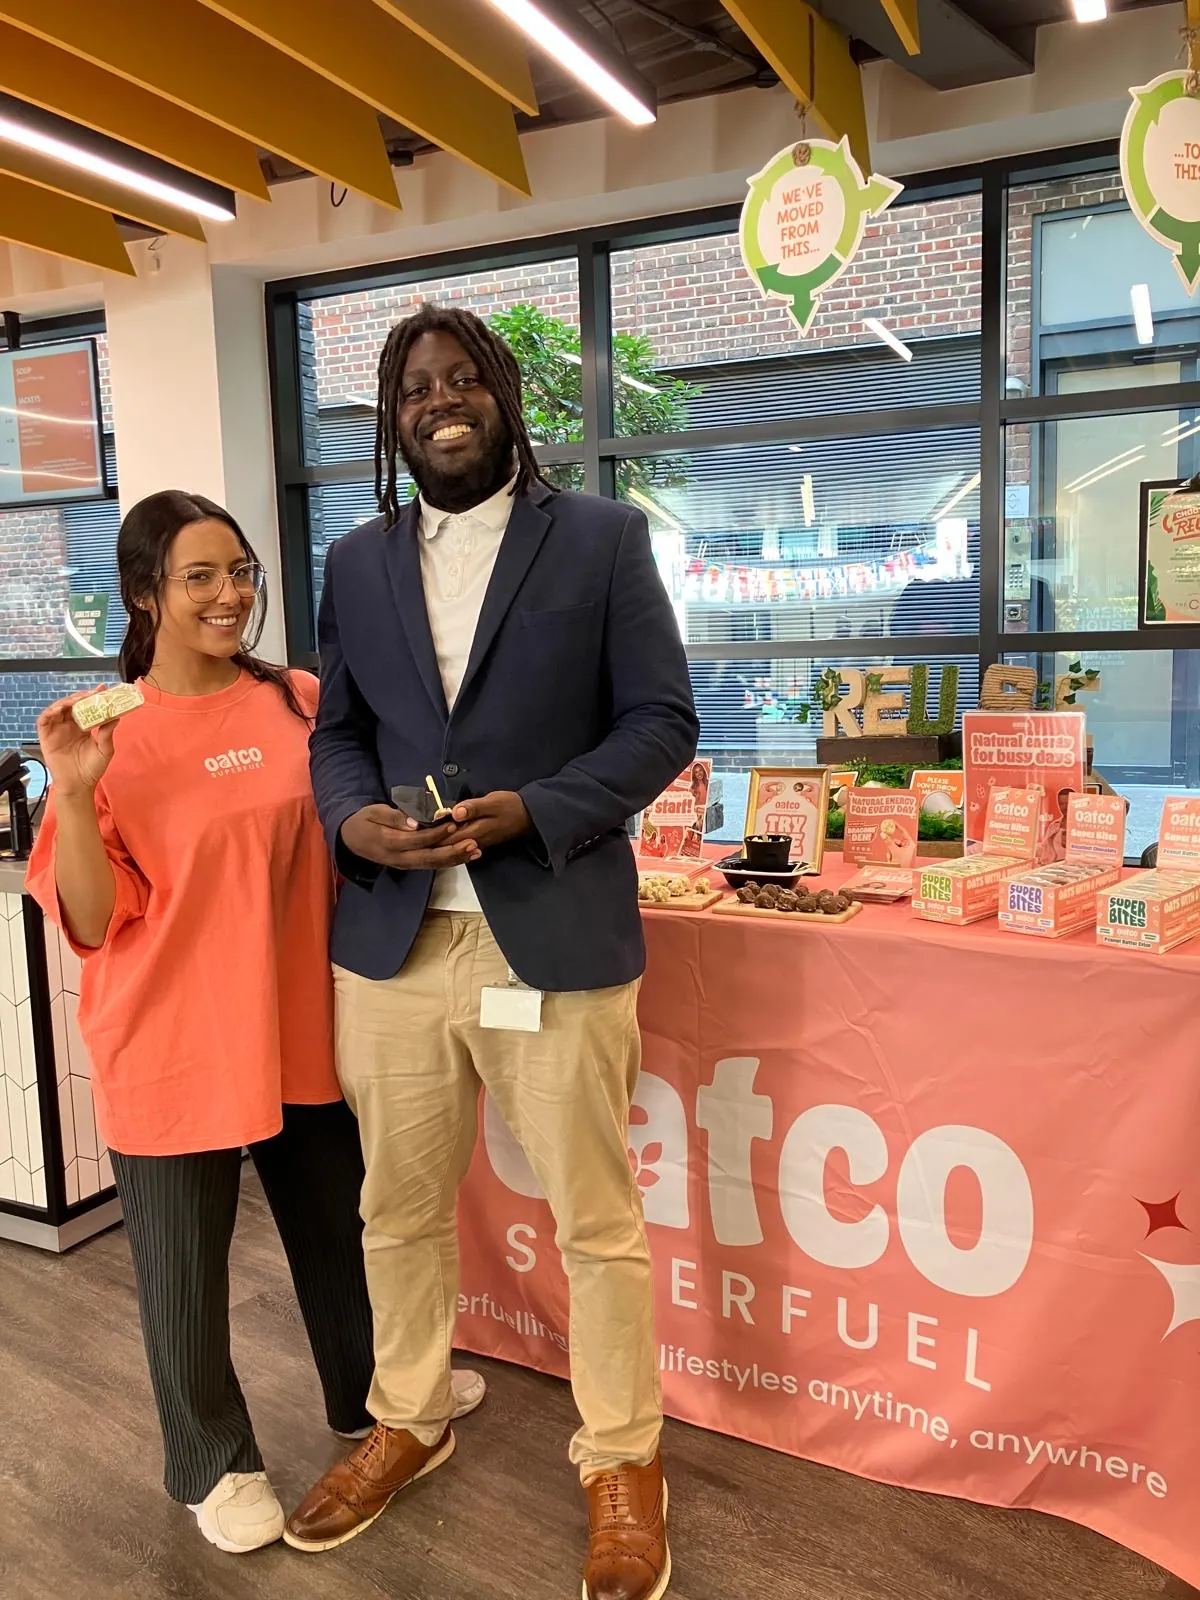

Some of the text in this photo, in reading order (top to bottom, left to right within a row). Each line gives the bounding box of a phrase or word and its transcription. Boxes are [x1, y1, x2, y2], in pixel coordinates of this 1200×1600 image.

[782, 182, 823, 205] WE'VE
[777, 201, 824, 225] MOVED
[781, 220, 819, 241] FROM
[781, 241, 820, 259] THIS...
[972, 734, 1023, 748] Natural
[204, 746, 263, 772] oatco
[972, 748, 1074, 766] for busy days
[655, 799, 693, 814] start!
[851, 805, 914, 814] FOR EVERY DAY
[852, 797, 915, 806] NATURAL ENERGY
[994, 802, 1029, 817] oatco
[766, 814, 807, 833] TRY
[1075, 810, 1115, 826] oatco
[921, 873, 952, 893] SUPER
[921, 881, 951, 902] BITES
[1009, 884, 1042, 905] SUPER
[1009, 894, 1042, 914] BITES
[1109, 897, 1146, 918] SUPER
[1109, 907, 1146, 927] BITES
[505, 1223, 992, 1393] SERFUEL
[659, 1343, 798, 1395] lifestyles
[808, 1378, 958, 1448] anytime,
[969, 1429, 1168, 1499] anywhere
